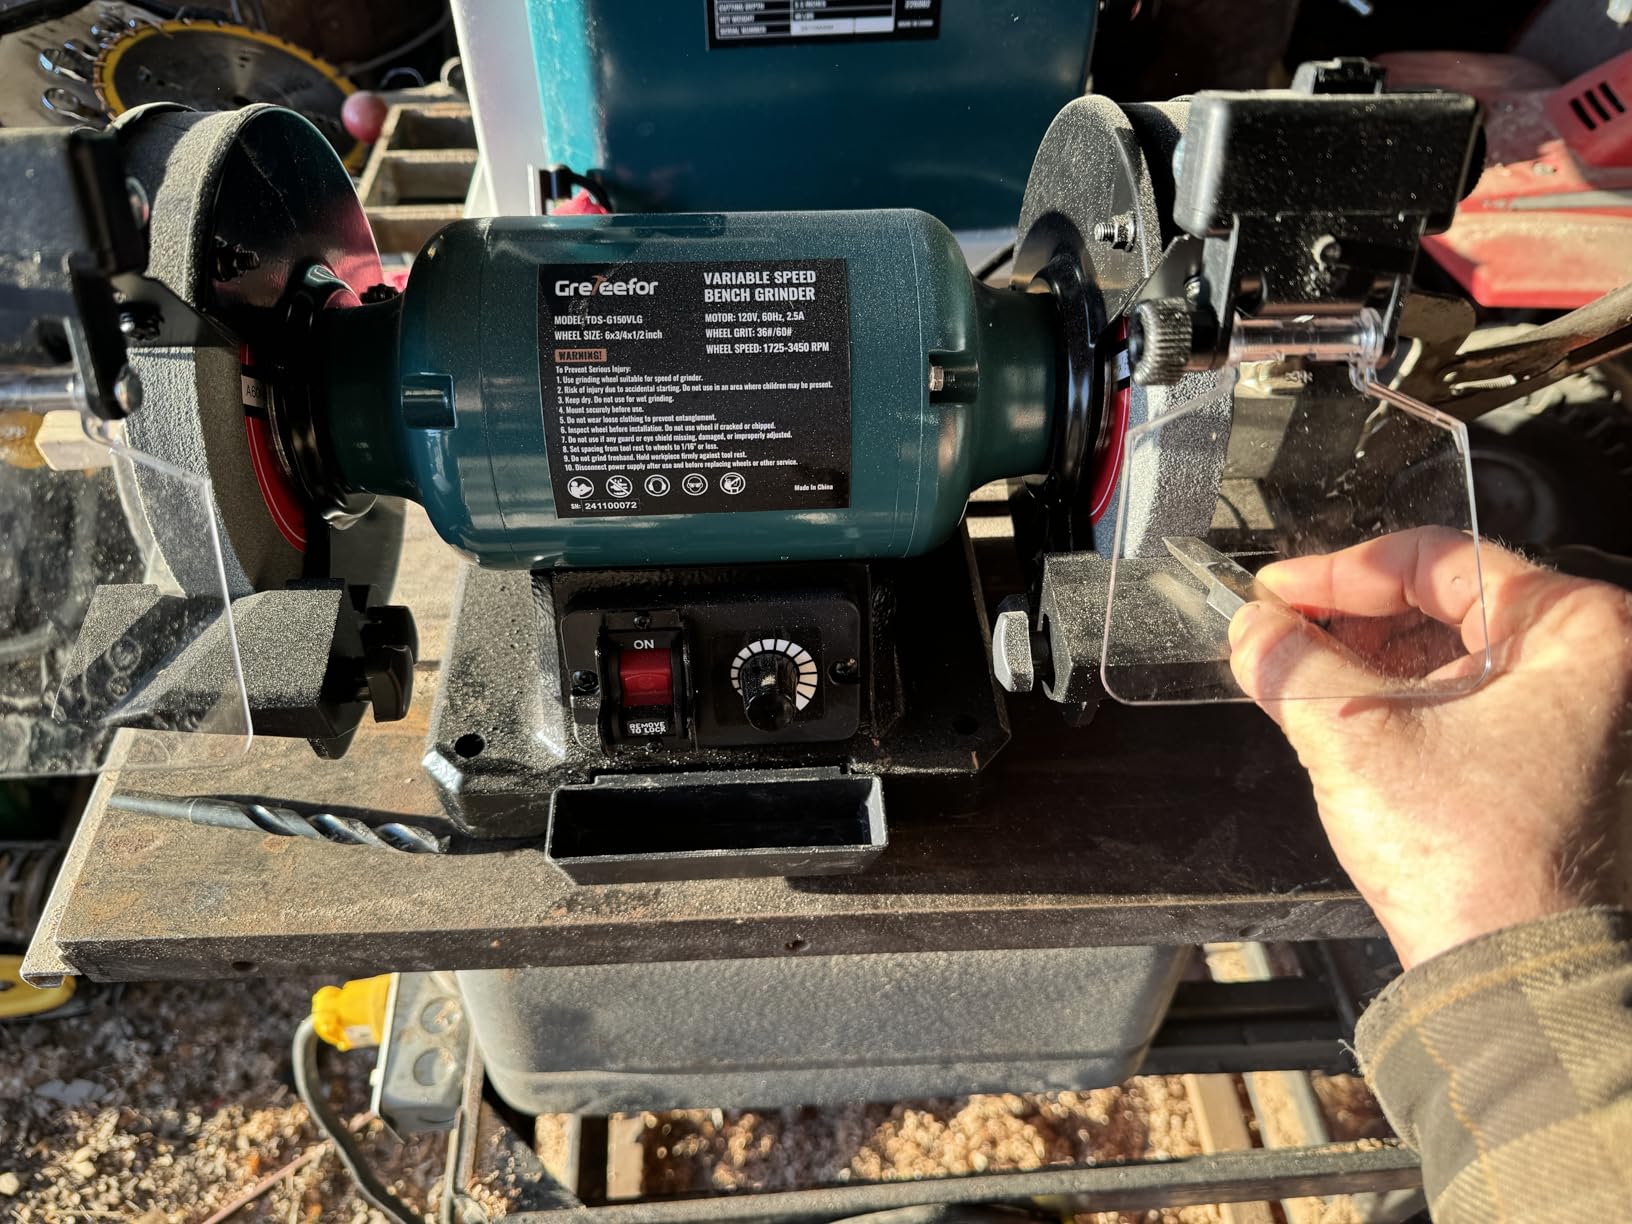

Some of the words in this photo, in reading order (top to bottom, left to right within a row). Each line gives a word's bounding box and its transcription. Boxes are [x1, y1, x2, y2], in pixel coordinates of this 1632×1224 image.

[703, 272, 770, 284] VARIABLE
[774, 270, 816, 284] SPEED
[705, 288, 750, 302] BENCH
[755, 287, 816, 301] GRINDER
[554, 315, 584, 325] MODEL:
[586, 315, 643, 324] TDS-G150VLG
[705, 313, 736, 322] MOTOR:
[738, 312, 760, 322] 120V,
[762, 312, 784, 322] 60Hz,
[787, 311, 804, 321] 2.5A
[554, 331, 581, 340] WHEEL
[584, 330, 603, 340] SIZE:
[706, 328, 732, 338] WHEEL
[734, 328, 755, 337] GRIT:
[757, 327, 792, 337] 36#/60#
[706, 344, 733, 354] WHEEL
[735, 343, 761, 353] SPEED:
[763, 342, 809, 352] 1725-3450
[811, 342, 829, 351] RPM
[559, 351, 602, 360] WARNING!
[564, 365, 587, 373] Prevent
[575, 375, 600, 384] grinding
[654, 374, 672, 383] speed
[680, 374, 704, 382] grinder.
[579, 385, 585, 393] of
[586, 385, 604, 394] injury
[625, 384, 655, 392] accidental
[656, 384, 681, 392] starting.
[809, 381, 833, 389] present.
[565, 396, 580, 404] Keep
[581, 396, 593, 404] dry.
[603, 395, 613, 403] not
[648, 395, 675, 403] grinding.
[586, 406, 610, 414] securely
[619, 415, 644, 423] clothing
[652, 414, 674, 423] prevent
[675, 414, 717, 422] entanglement.
[568, 426, 590, 434] Inspect
[751, 422, 776, 430] chipped.
[606, 436, 616, 444] any
[617, 435, 635, 443] guard
[734, 432, 765, 440] improperly
[766, 431, 793, 440] adjusted.
[570, 445, 580, 453] Set
[581, 445, 604, 453] spacing
[653, 443, 673, 451] wheels
[580, 454, 590, 462] not
[591, 454, 607, 463] grind
[651, 453, 680, 461] workpiece
[681, 452, 698, 460] firmly
[699, 451, 720, 460] against
[627, 462, 645, 471] supply
[704, 460, 731, 469] replacing
[776, 458, 798, 466] service.
[585, 502, 637, 510] 241100072
[634, 640, 654, 649] ON
[644, 726, 666, 734] LOCK
